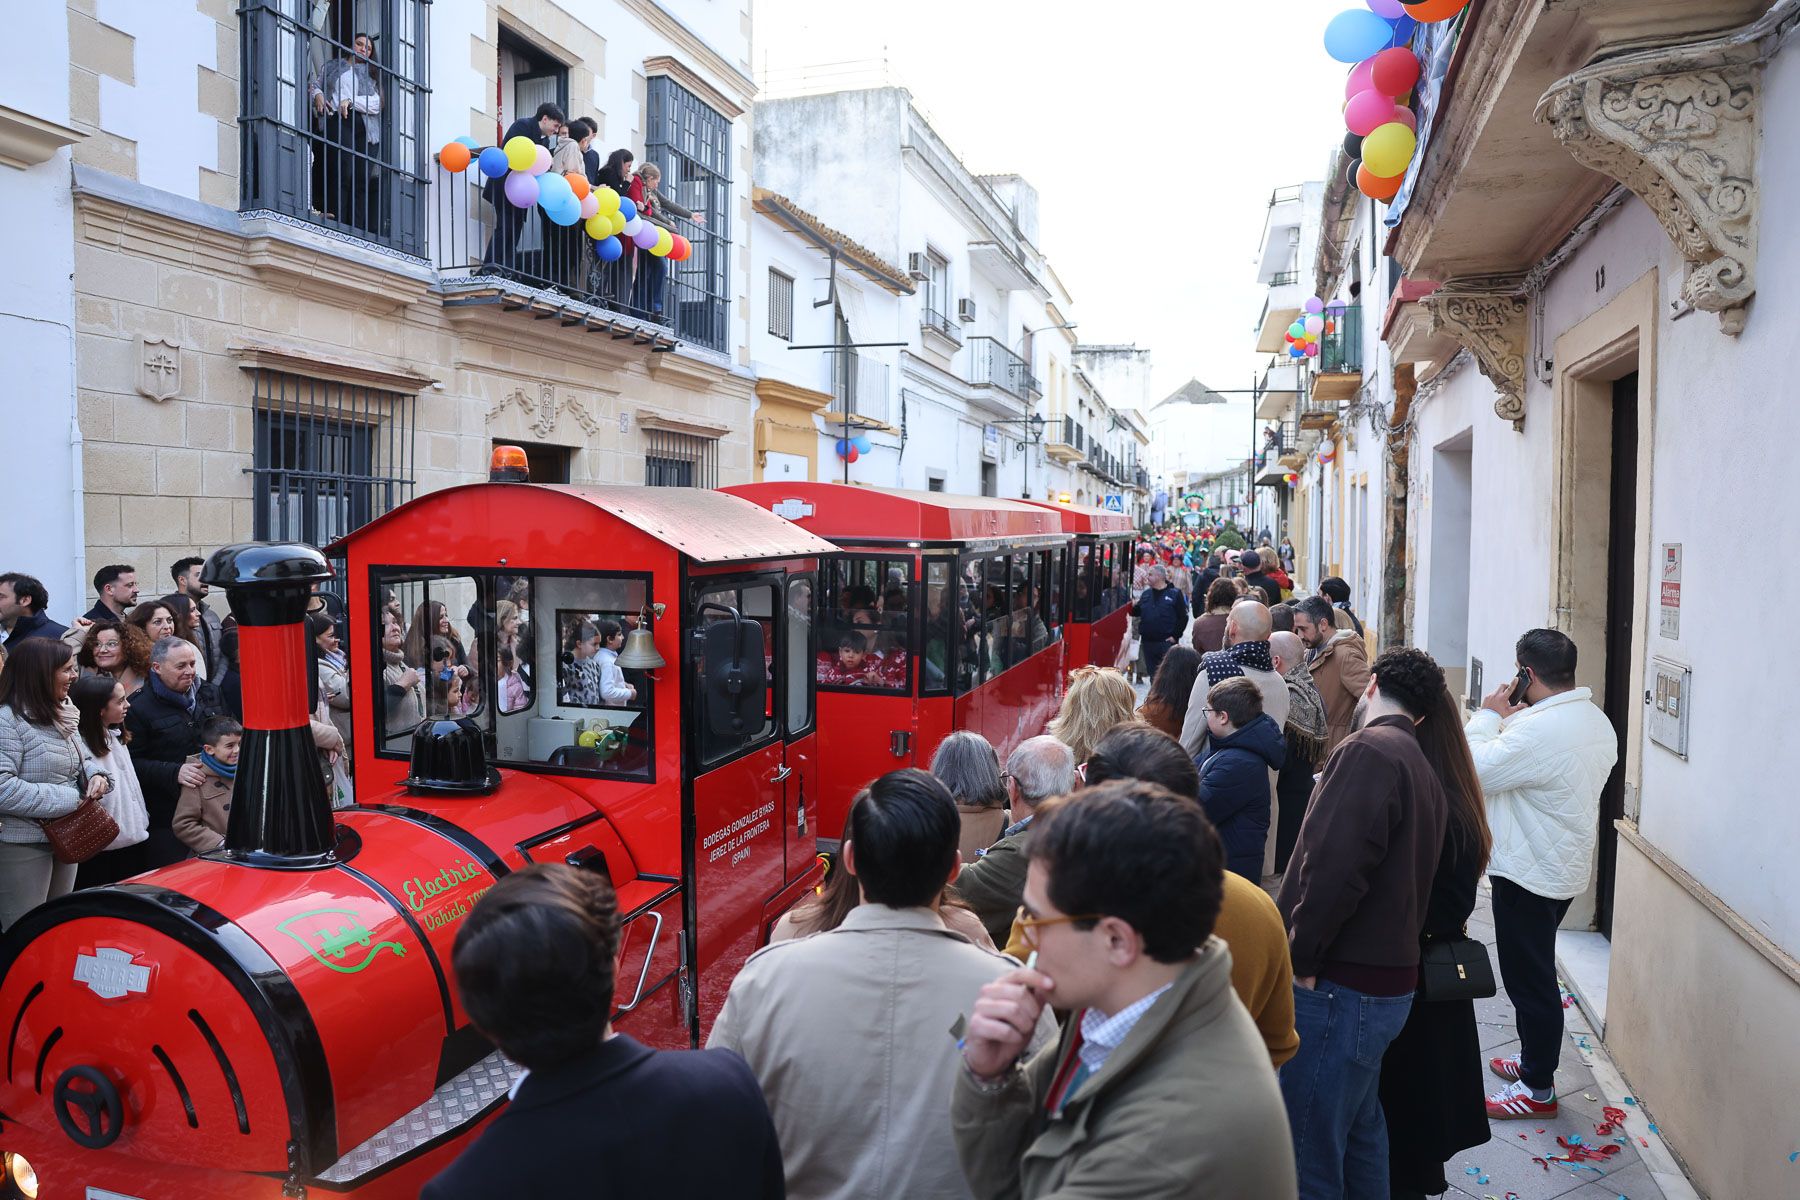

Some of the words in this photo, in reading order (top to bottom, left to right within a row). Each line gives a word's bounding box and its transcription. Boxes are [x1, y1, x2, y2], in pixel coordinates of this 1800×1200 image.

[703, 825, 731, 850] BODEGAS
[731, 809, 759, 833] GONZALEZ
[759, 800, 775, 818] BYASS
[709, 843, 728, 863] JEREZ
[727, 838, 736, 852] DE
[736, 834, 744, 847] LA
[744, 818, 770, 843] FRONTERA
[731, 845, 751, 868] (SPAIN)
[402, 859, 482, 912] Electric
[423, 901, 468, 931] Vehicle
